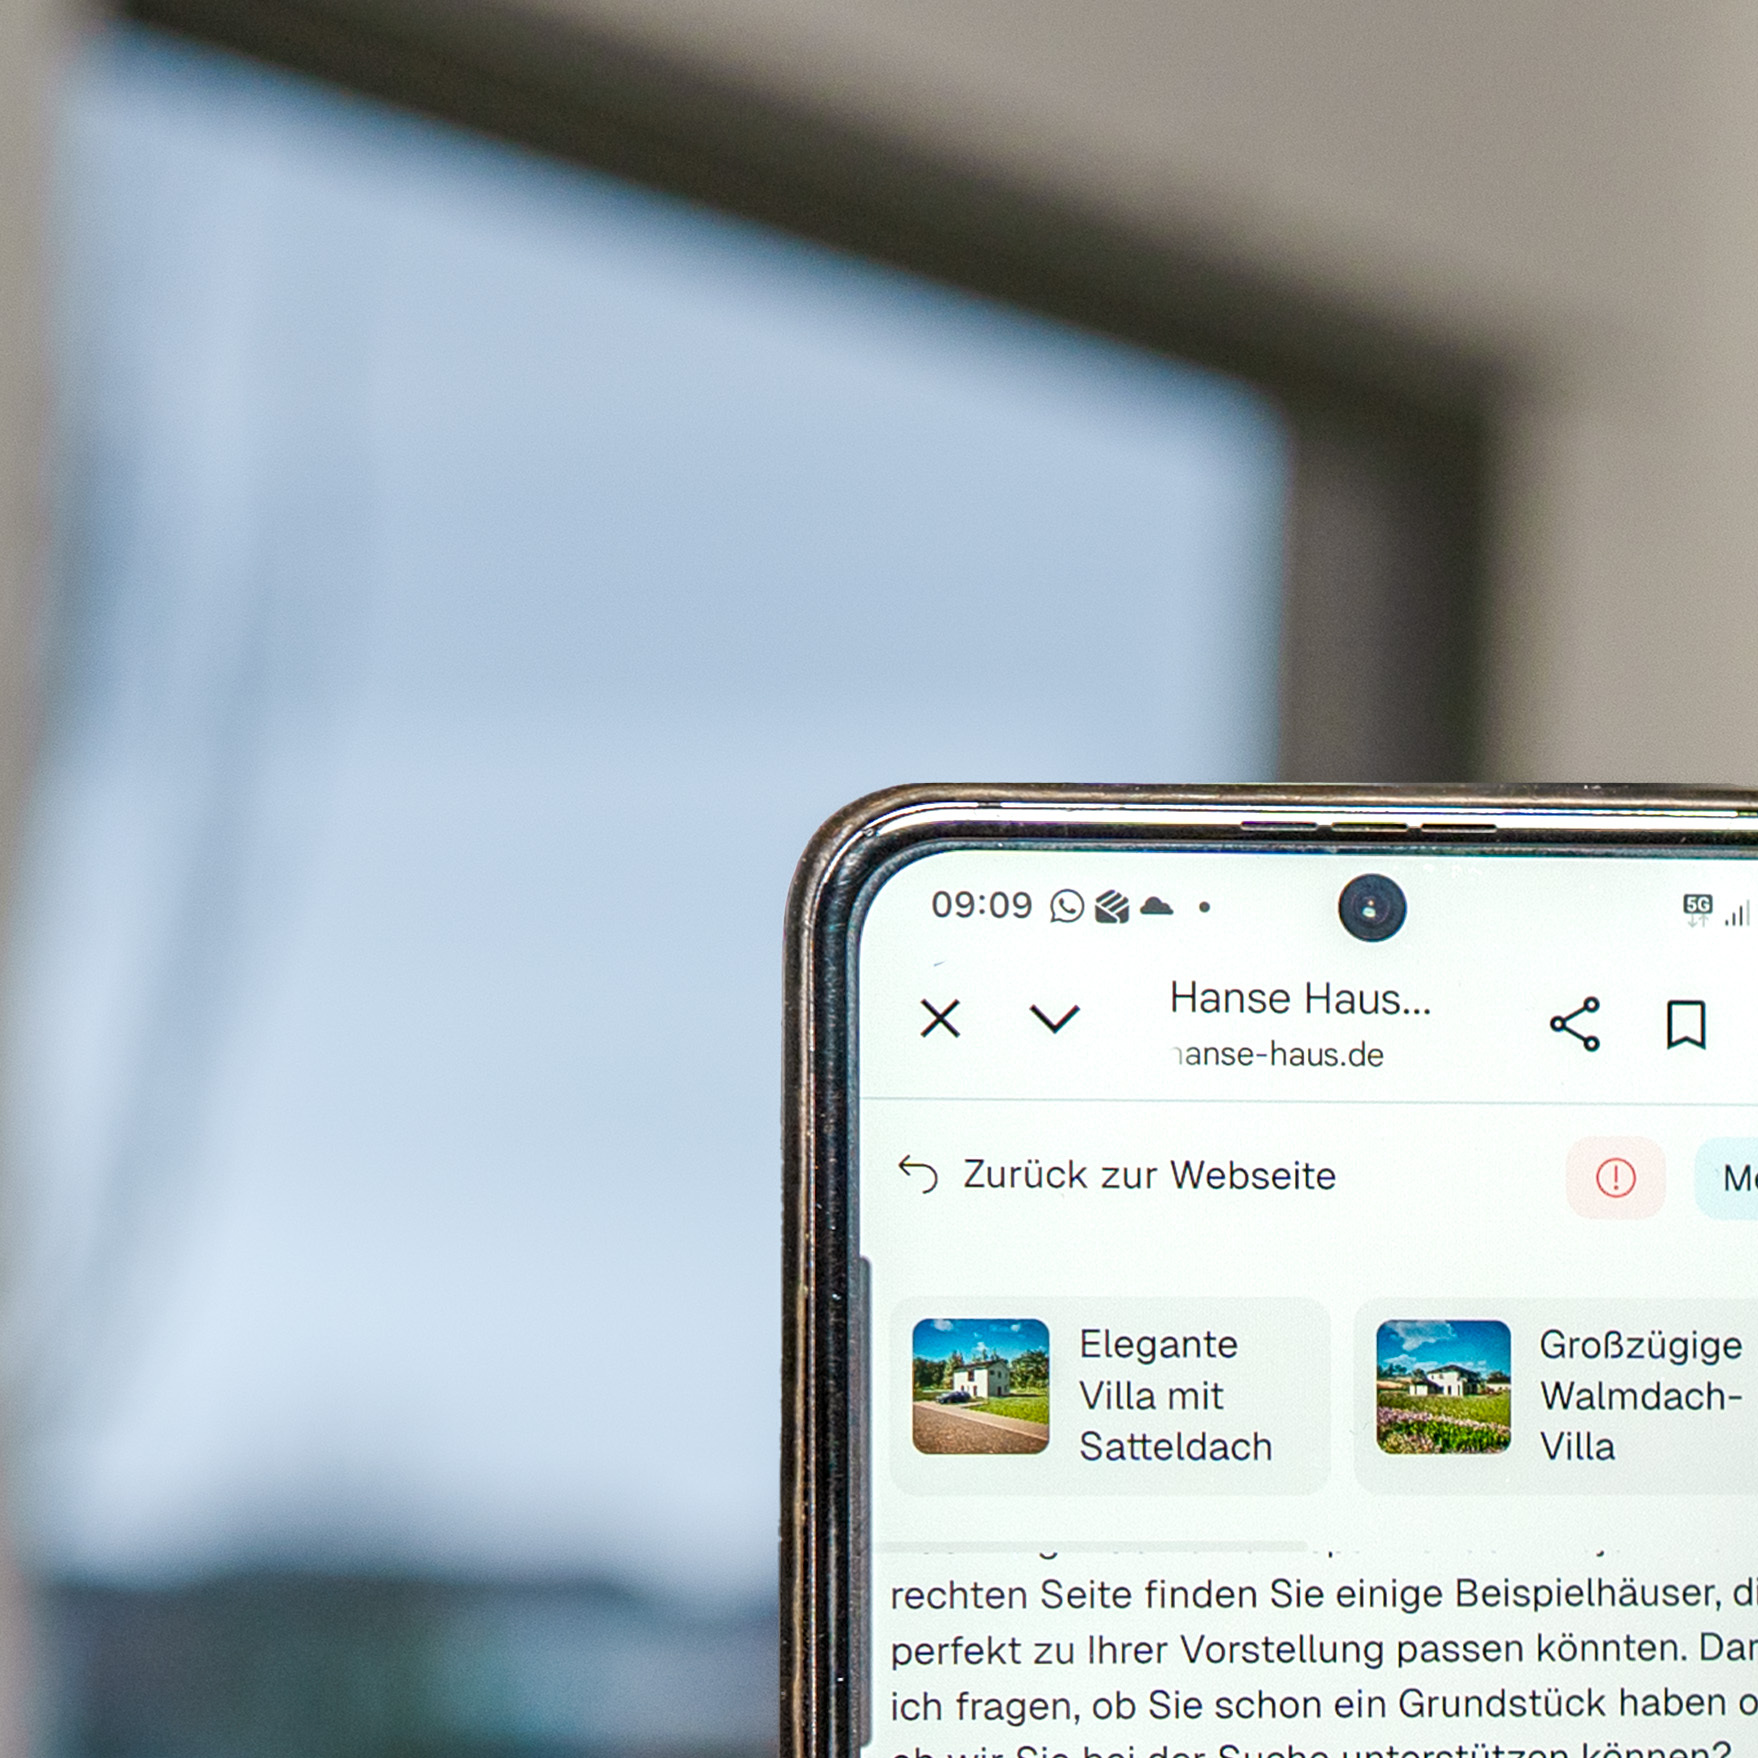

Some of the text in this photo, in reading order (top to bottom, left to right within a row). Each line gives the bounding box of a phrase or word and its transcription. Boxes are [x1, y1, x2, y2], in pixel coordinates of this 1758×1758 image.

[931, 890, 1033, 920] 09:09
[1686, 896, 1712, 913] 5G
[1171, 979, 1431, 1016] Hanse Haus...
[963, 1158, 1337, 1191] Zurück zur Webseite
[1081, 1328, 1239, 1366] Elegante
[1539, 1328, 1743, 1367] Großzügige
[1078, 1380, 1225, 1411] Villa mit
[1540, 1380, 1743, 1412] Walmdach-
[1080, 1430, 1272, 1462] Satteldach
[1539, 1430, 1616, 1462] Villa
[891, 1579, 1028, 1611] rechten
[1040, 1578, 1133, 1610] Seite
[1144, 1578, 1258, 1610] finden
[1270, 1577, 1325, 1609] Sie
[1335, 1578, 1444, 1615] einige
[1456, 1577, 1722, 1613] Beispielhäuser,
[891, 1635, 1022, 1672] perfekt
[1033, 1642, 1075, 1666] zu
[1088, 1634, 1169, 1665] Ihrer
[1180, 1633, 1384, 1671] Vorstellung
[1397, 1639, 1524, 1669] passen
[1536, 1632, 1688, 1663] könnten.
[891, 1691, 943, 1722] ich
[955, 1690, 1081, 1728] fragen,
[1092, 1690, 1137, 1721] ob
[1148, 1689, 1204, 1721] Sie
[1214, 1689, 1322, 1720] schon
[1334, 1688, 1387, 1719] ein
[1398, 1687, 1607, 1719] Grundstück
[1619, 1686, 1727, 1718] haben
